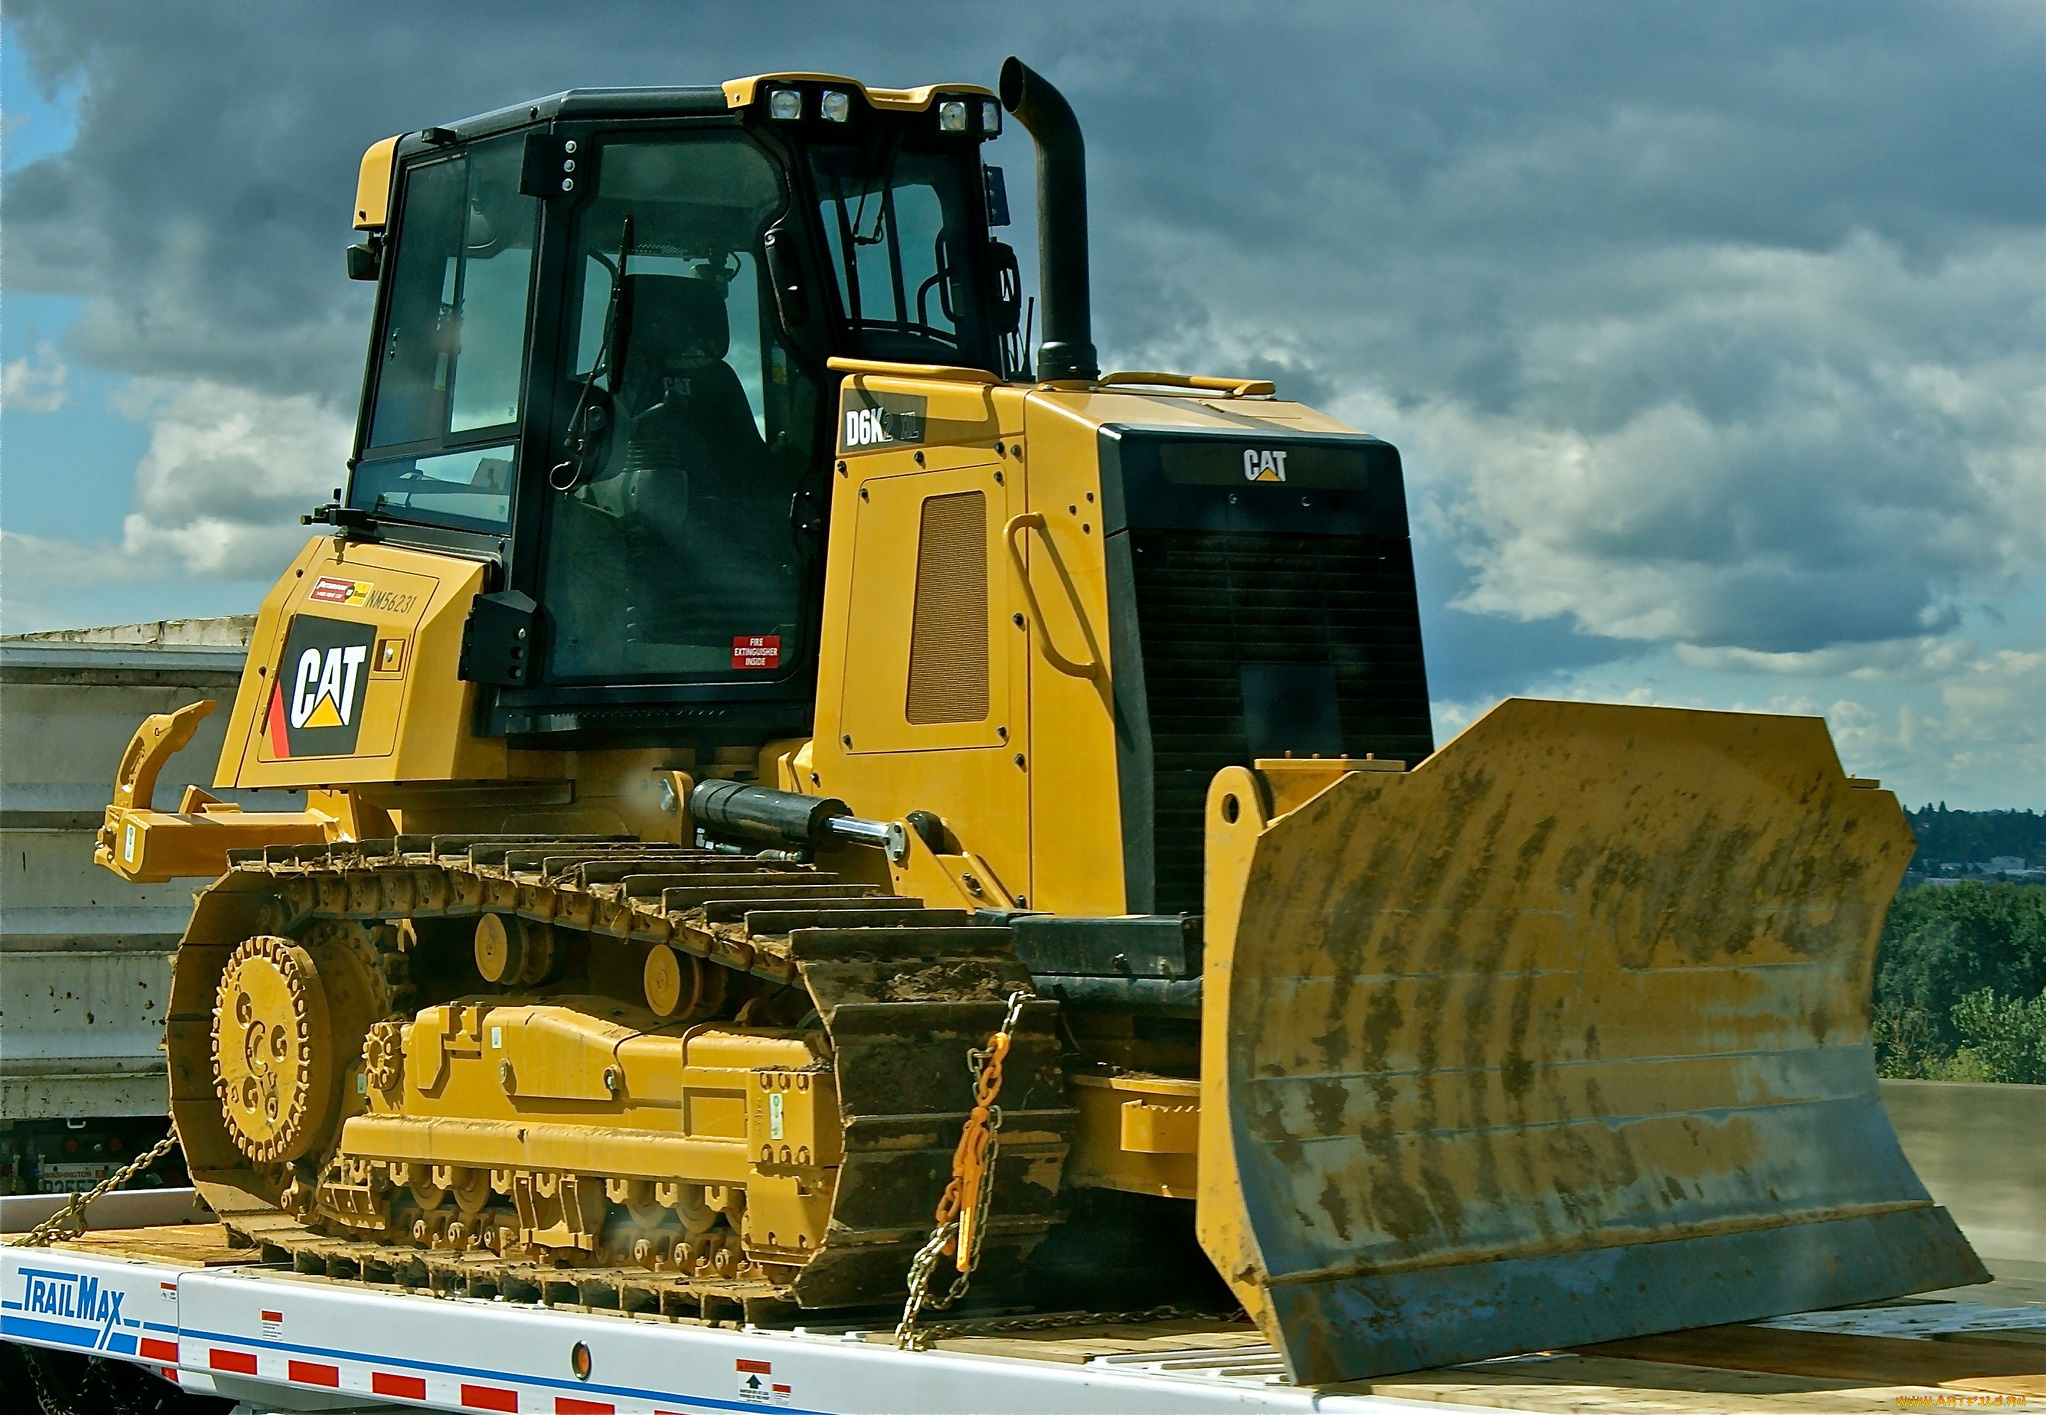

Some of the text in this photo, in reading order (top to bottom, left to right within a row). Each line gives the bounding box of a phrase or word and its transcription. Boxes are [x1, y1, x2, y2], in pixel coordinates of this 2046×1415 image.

[1243, 449, 1287, 482] CAT
[365, 589, 417, 614] NM56231
[750, 638, 764, 646] FIRE
[734, 647, 778, 656] EXTINGUISHER
[745, 657, 766, 666] INSIDE
[290, 645, 367, 729] CAT
[44, 1171, 92, 1179] WASHINGTON
